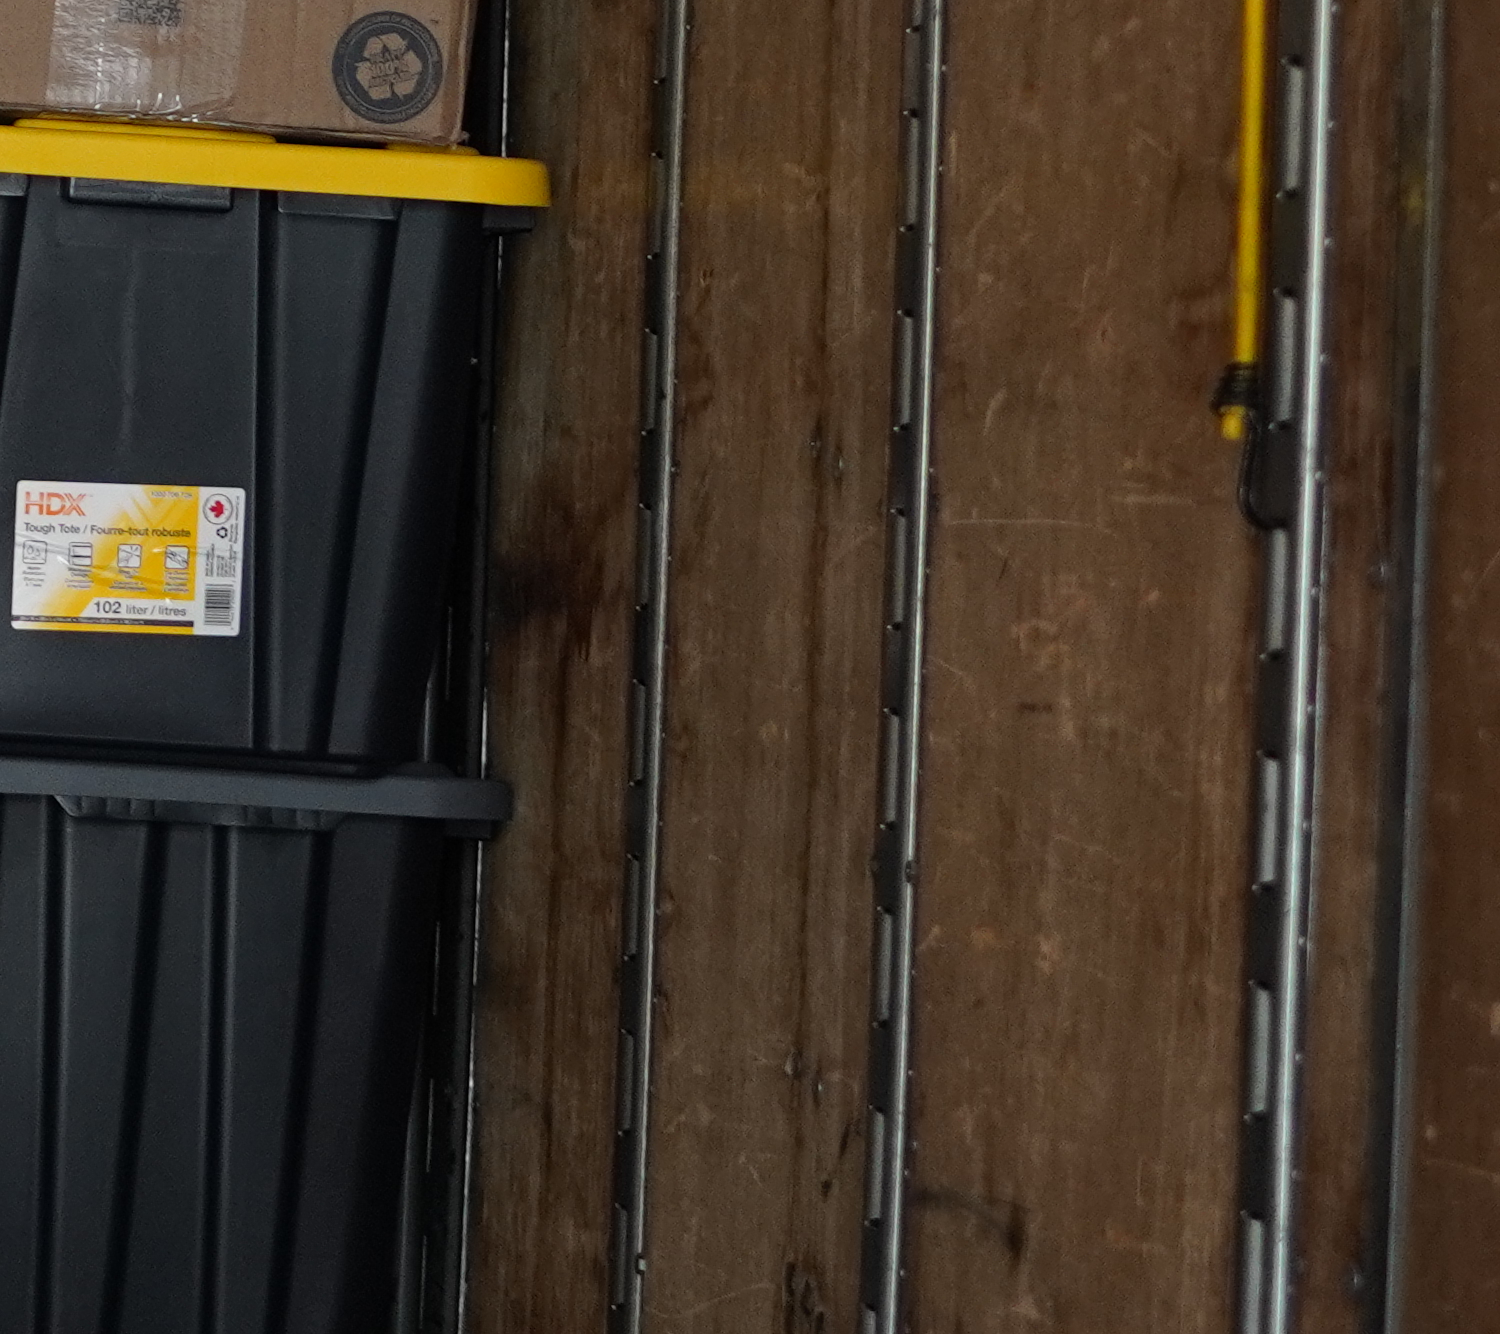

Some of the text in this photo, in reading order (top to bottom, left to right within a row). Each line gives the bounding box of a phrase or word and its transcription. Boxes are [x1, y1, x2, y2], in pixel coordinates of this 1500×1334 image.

[24, 491, 87, 517] HDX
[24, 522, 56, 534] Tough
[57, 524, 81, 535] Tote
[90, 524, 150, 536] Fourre-tout
[151, 527, 192, 538] robuste
[94, 600, 122, 614] 102
[125, 603, 148, 615] liter
[158, 604, 187, 617] litres
